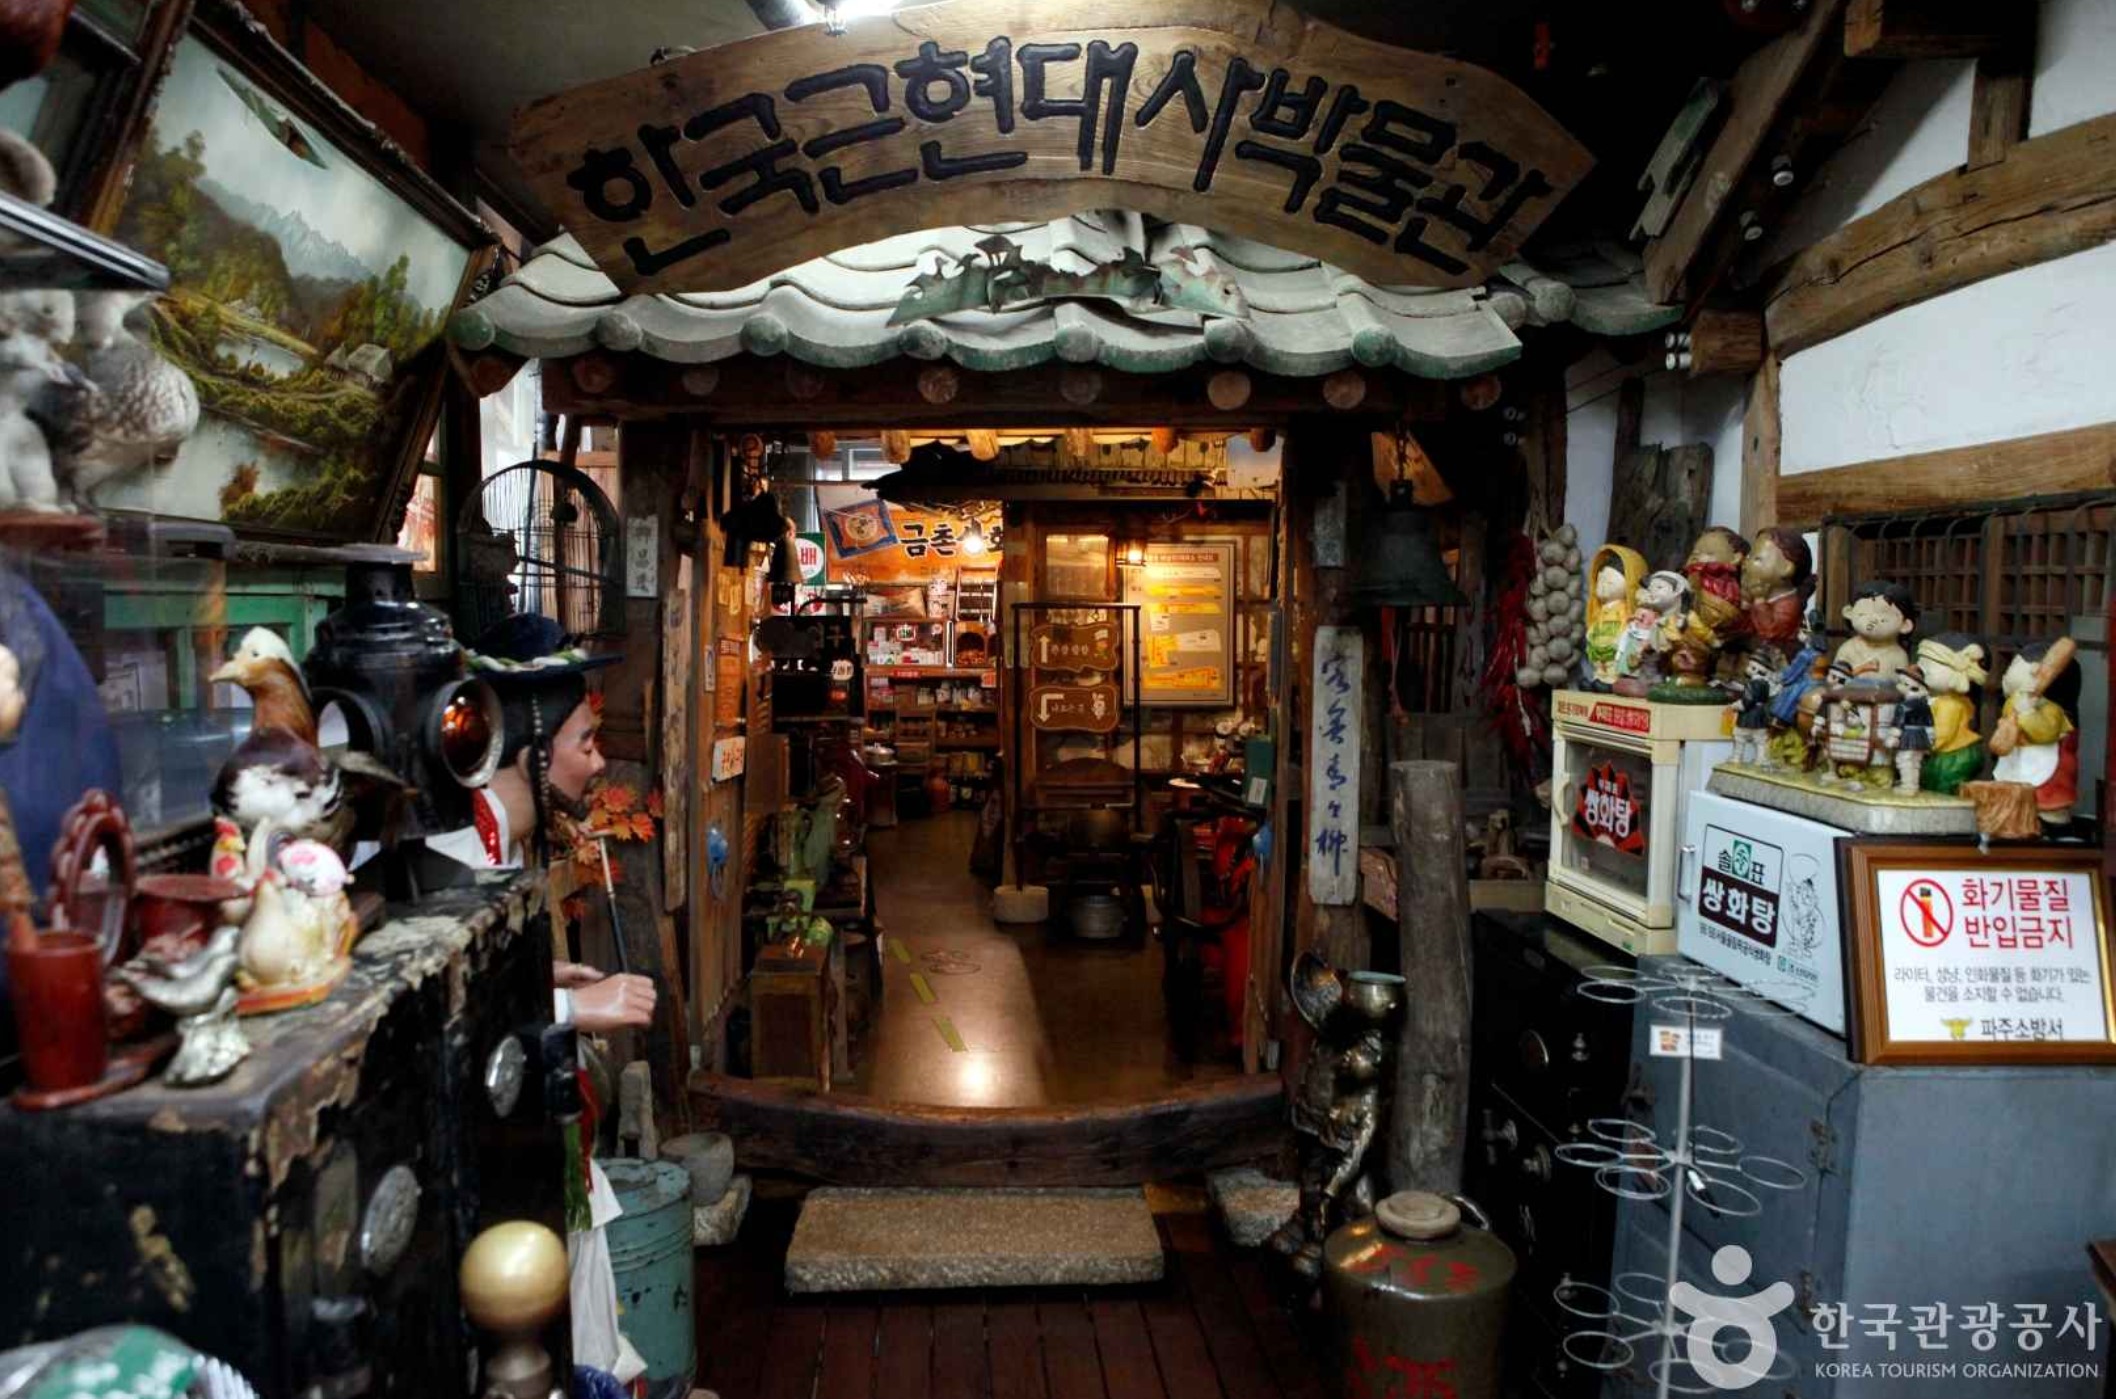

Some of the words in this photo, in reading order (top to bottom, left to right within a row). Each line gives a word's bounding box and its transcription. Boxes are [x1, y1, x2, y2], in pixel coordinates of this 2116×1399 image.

[566, 35, 1552, 277] 한국근현대사박물관
[1584, 788, 1631, 838] 쌍화탕
[1703, 878, 1776, 934] 쌍화탕
[1961, 878, 2070, 912] 화기물질
[1964, 917, 2074, 949] 반입금지
[1964, 966, 2010, 983] 인화물질
[2014, 966, 2026, 983] 등
[1963, 985, 1997, 1002] 소지할
[2001, 986, 2012, 1003] 수
[1980, 1018, 2064, 1040] 파주소방서
